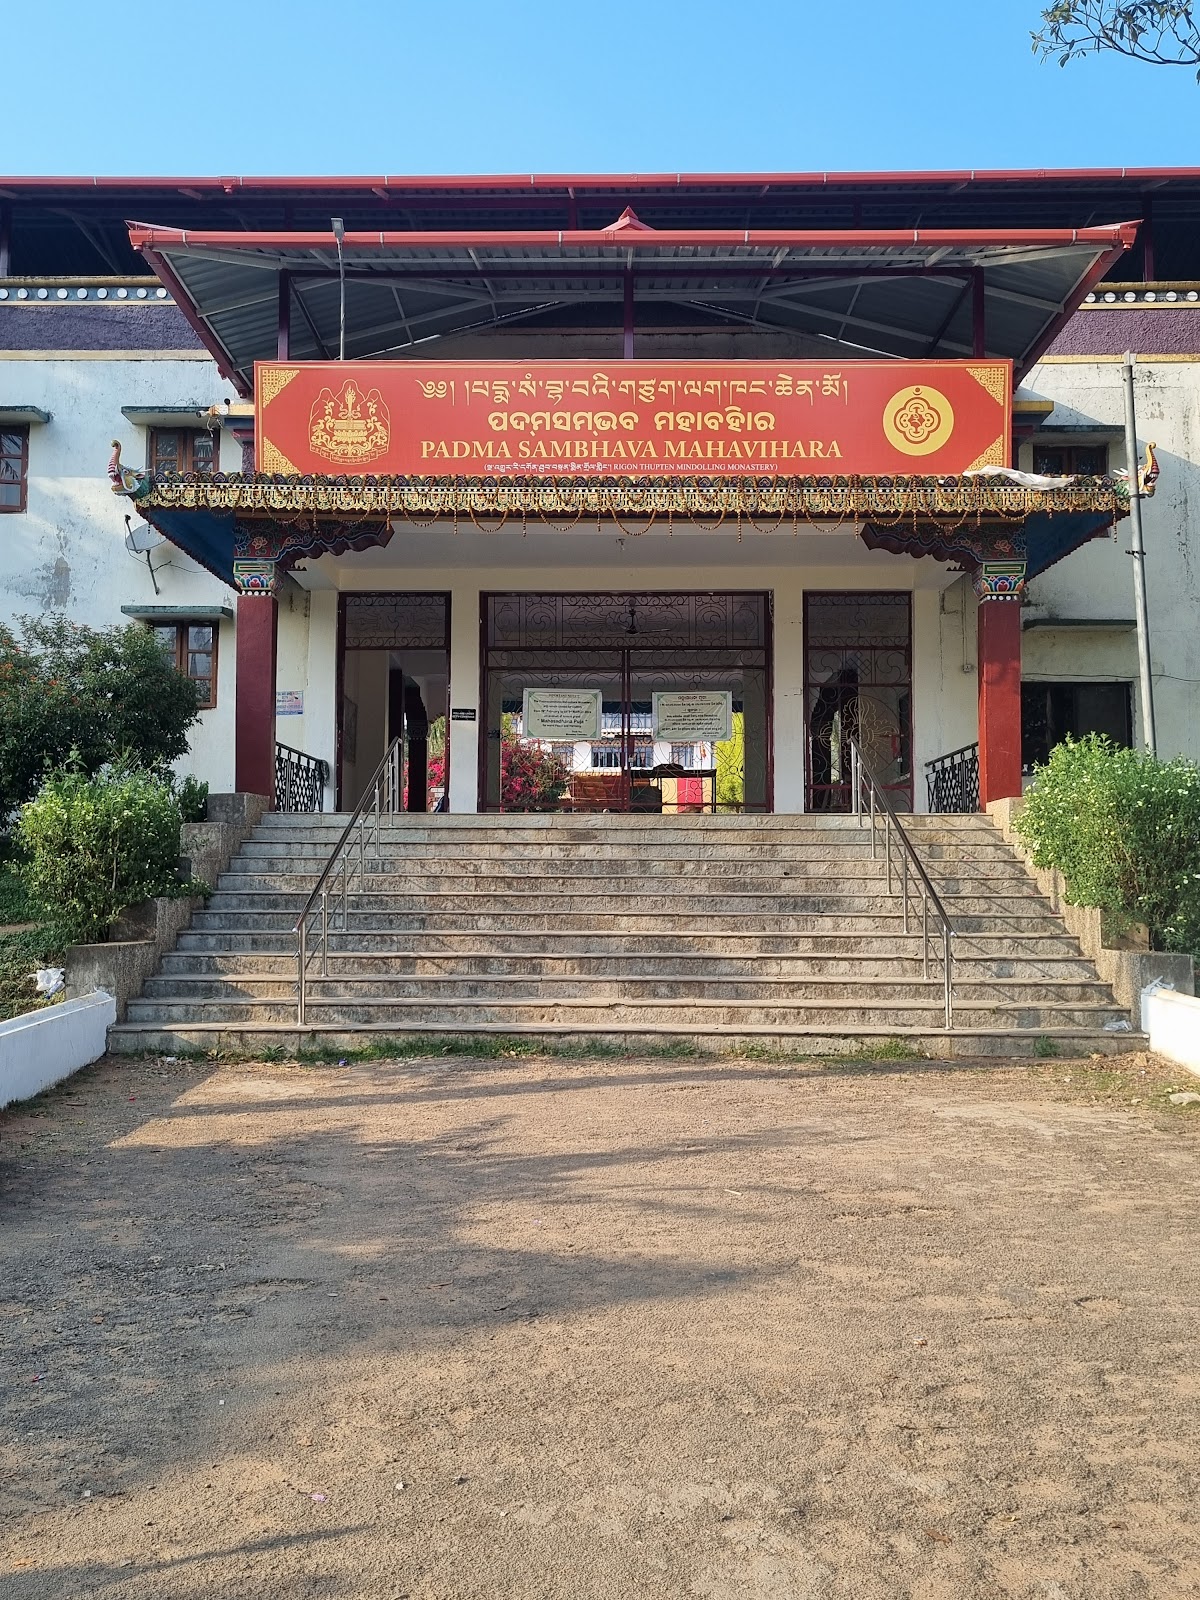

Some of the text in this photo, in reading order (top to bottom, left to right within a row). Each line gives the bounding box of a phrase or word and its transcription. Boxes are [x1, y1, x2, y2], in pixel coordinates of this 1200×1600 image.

[421, 440, 843, 459] PADMA SAMBHAVA MAHAVIHARA
[613, 463, 638, 471] RIGON
[640, 463, 675, 471] THUPTEN
[676, 463, 726, 471] MINDOLLING
[727, 463, 778, 472] MONASTERY)
